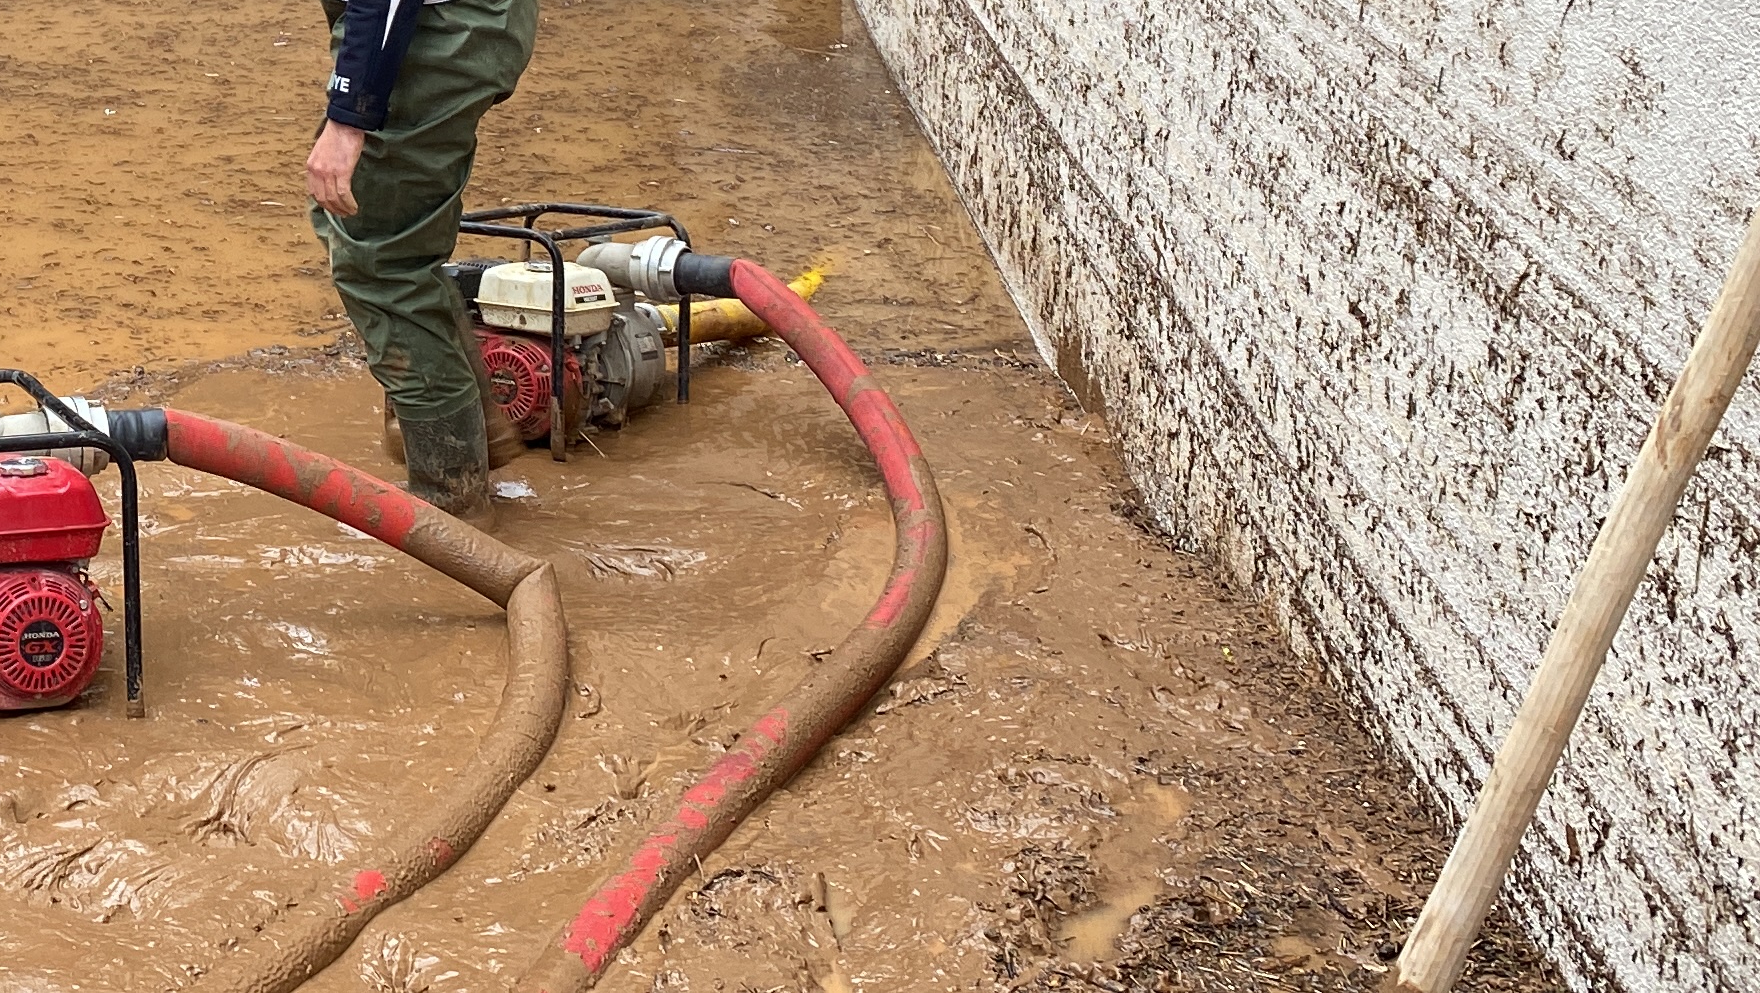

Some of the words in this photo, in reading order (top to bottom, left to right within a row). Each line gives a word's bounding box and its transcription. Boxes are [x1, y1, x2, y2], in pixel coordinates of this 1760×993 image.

[571, 283, 605, 295] HONDA
[23, 631, 60, 639] HONDA
[25, 641, 58, 654] GX
